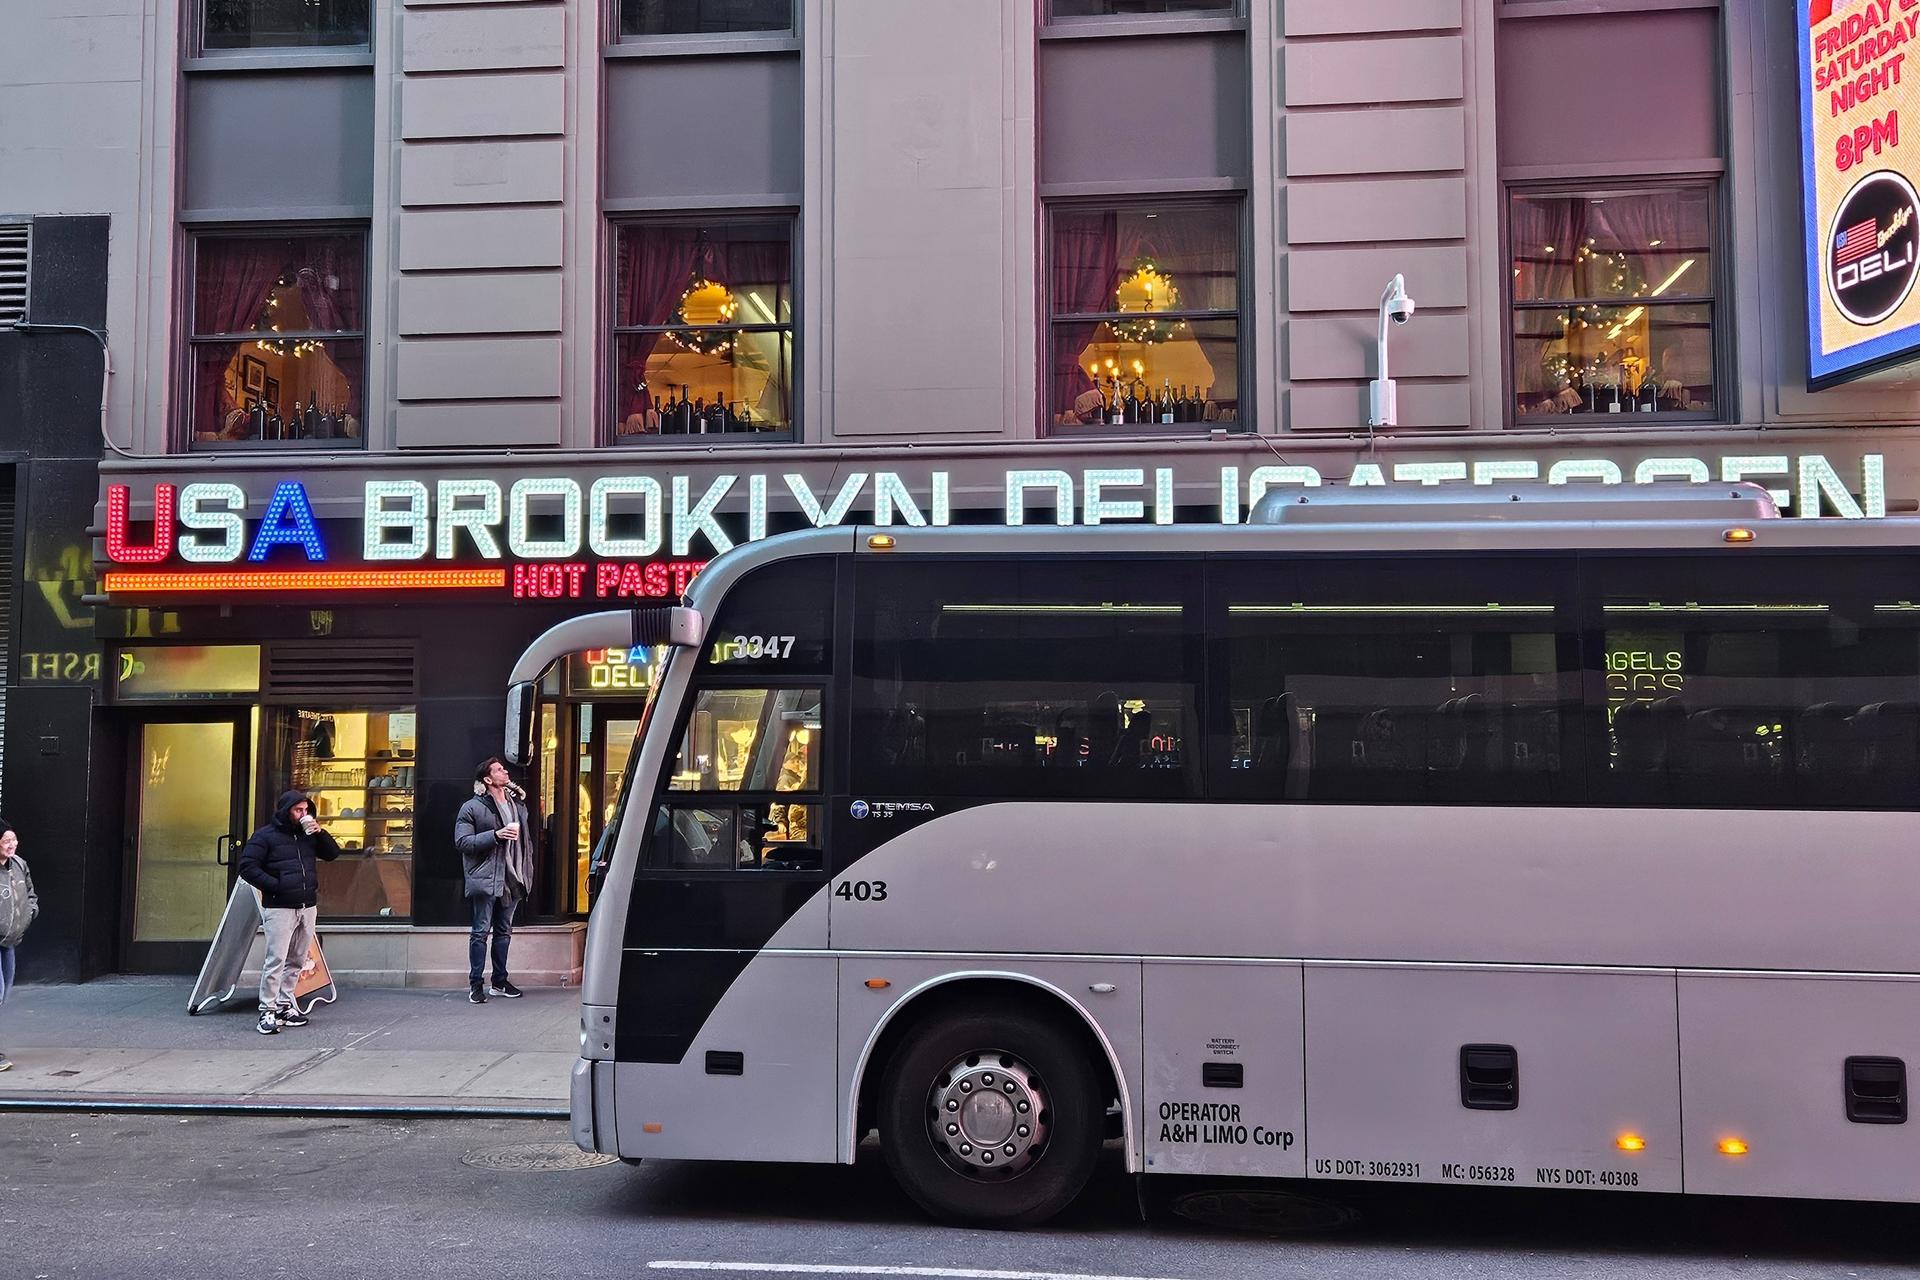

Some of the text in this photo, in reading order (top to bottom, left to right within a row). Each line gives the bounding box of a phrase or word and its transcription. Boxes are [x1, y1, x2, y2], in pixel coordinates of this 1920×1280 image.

[1815, 0, 1891, 63] FRIDAY
[1815, 10, 1920, 91] SATURDAY
[1830, 53, 1905, 117] NIGHT
[1835, 110, 1899, 172] 8PM
[1837, 240, 1913, 290] DELI
[105, 481, 328, 563] USA
[513, 562, 707, 598] HOT PAST
[733, 635, 796, 659] 3347
[590, 664, 660, 688] DELI
[872, 802, 935, 812] TEMSA
[835, 881, 888, 901] 403
[1159, 1102, 1241, 1123] OPERATOR
[1159, 1123, 1294, 1151] A&H LIMO Corp
[1315, 1159, 1639, 1186] US DOT: 3062931 MC: 056328 NYS DOT: 40308
